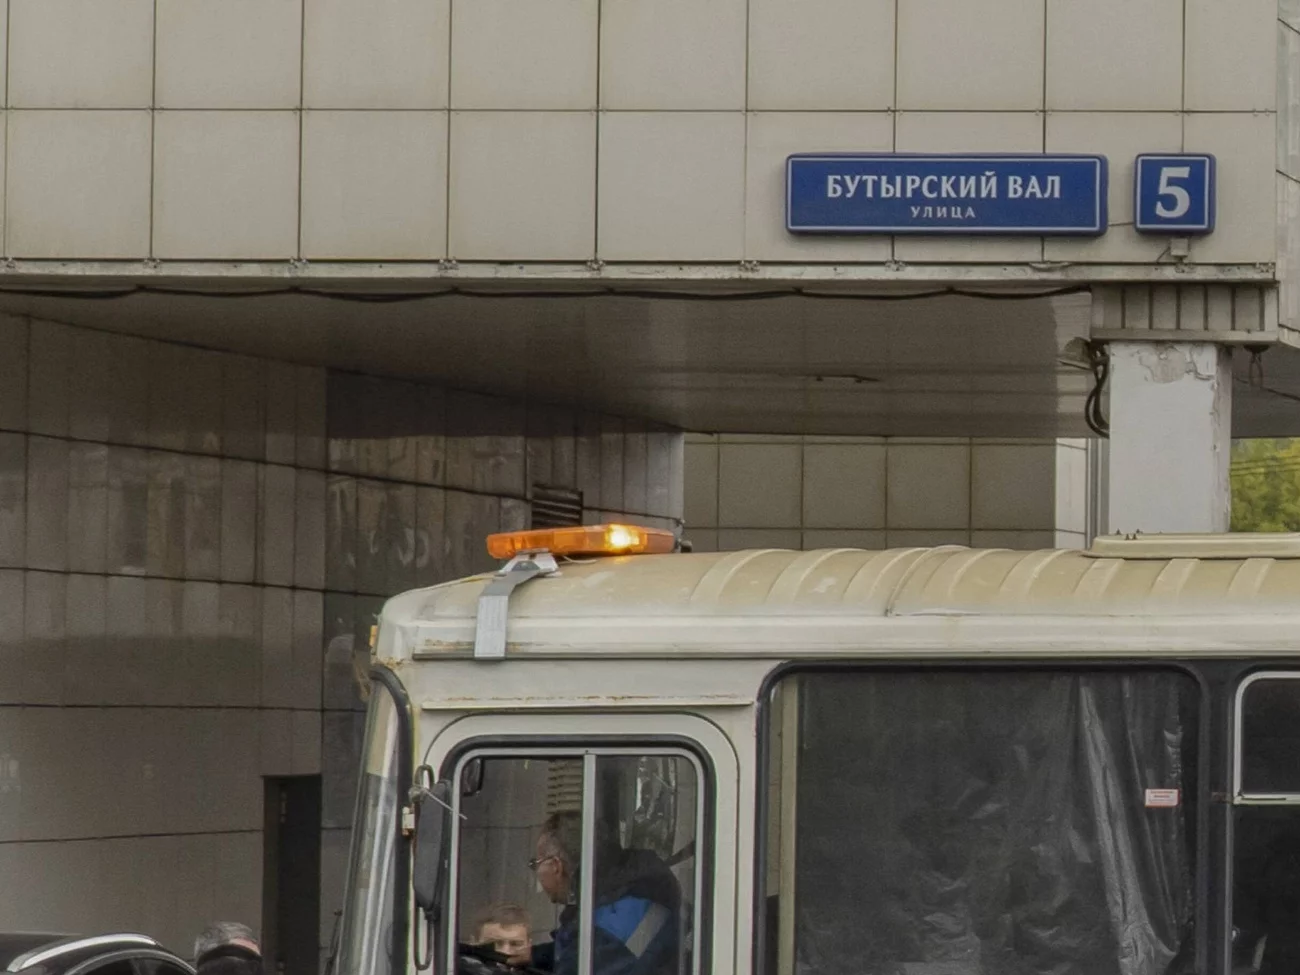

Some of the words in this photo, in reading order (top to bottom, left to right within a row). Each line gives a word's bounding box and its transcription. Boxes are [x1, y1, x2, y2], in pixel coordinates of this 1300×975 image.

[827, 170, 997, 199] БУТЫРСКИЙ
[1007, 175, 1061, 199] ВАЛ
[1155, 166, 1191, 218] 5
[910, 206, 976, 219] УЛИЦА
